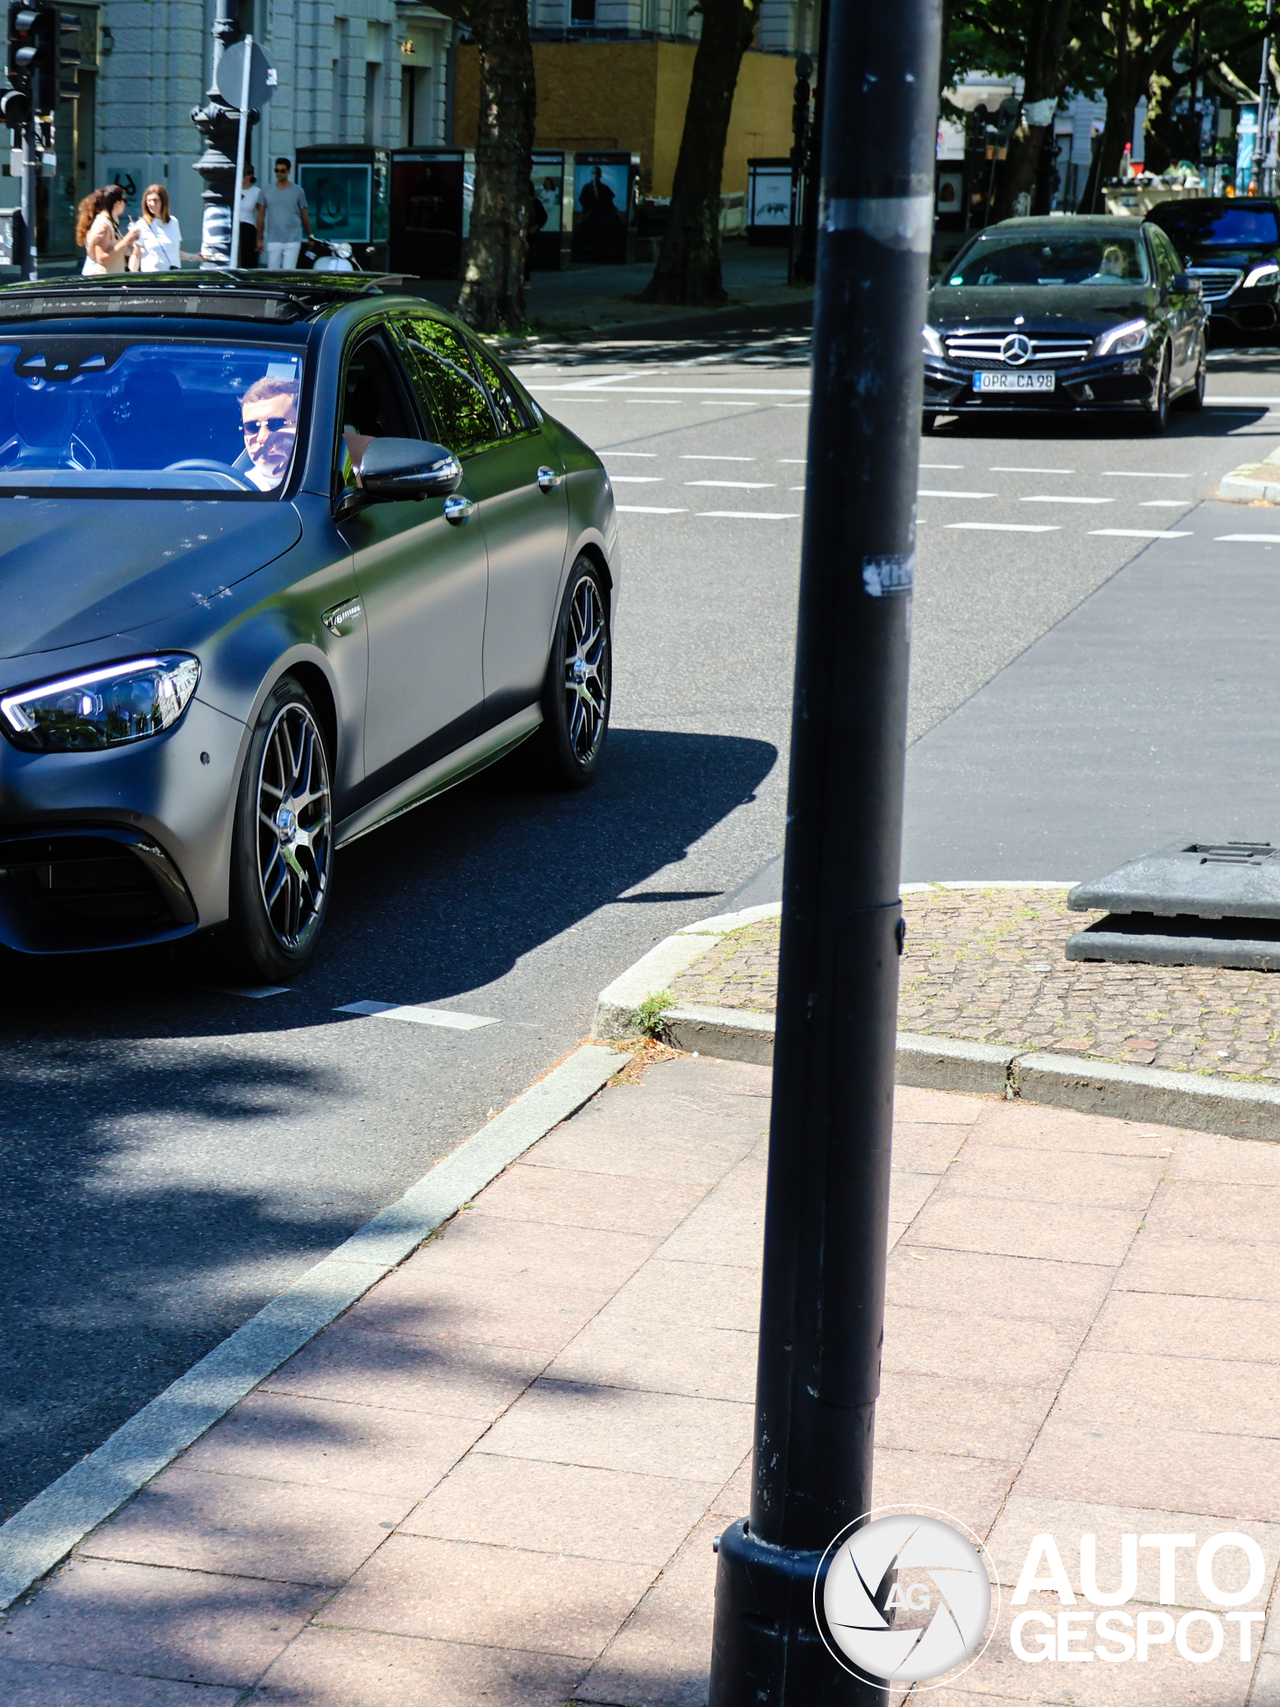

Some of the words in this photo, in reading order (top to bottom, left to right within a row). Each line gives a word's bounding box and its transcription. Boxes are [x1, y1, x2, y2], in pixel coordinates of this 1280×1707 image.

[983, 374, 1008, 387] OPR
[1017, 374, 1033, 387] CA
[1037, 374, 1053, 387] 98
